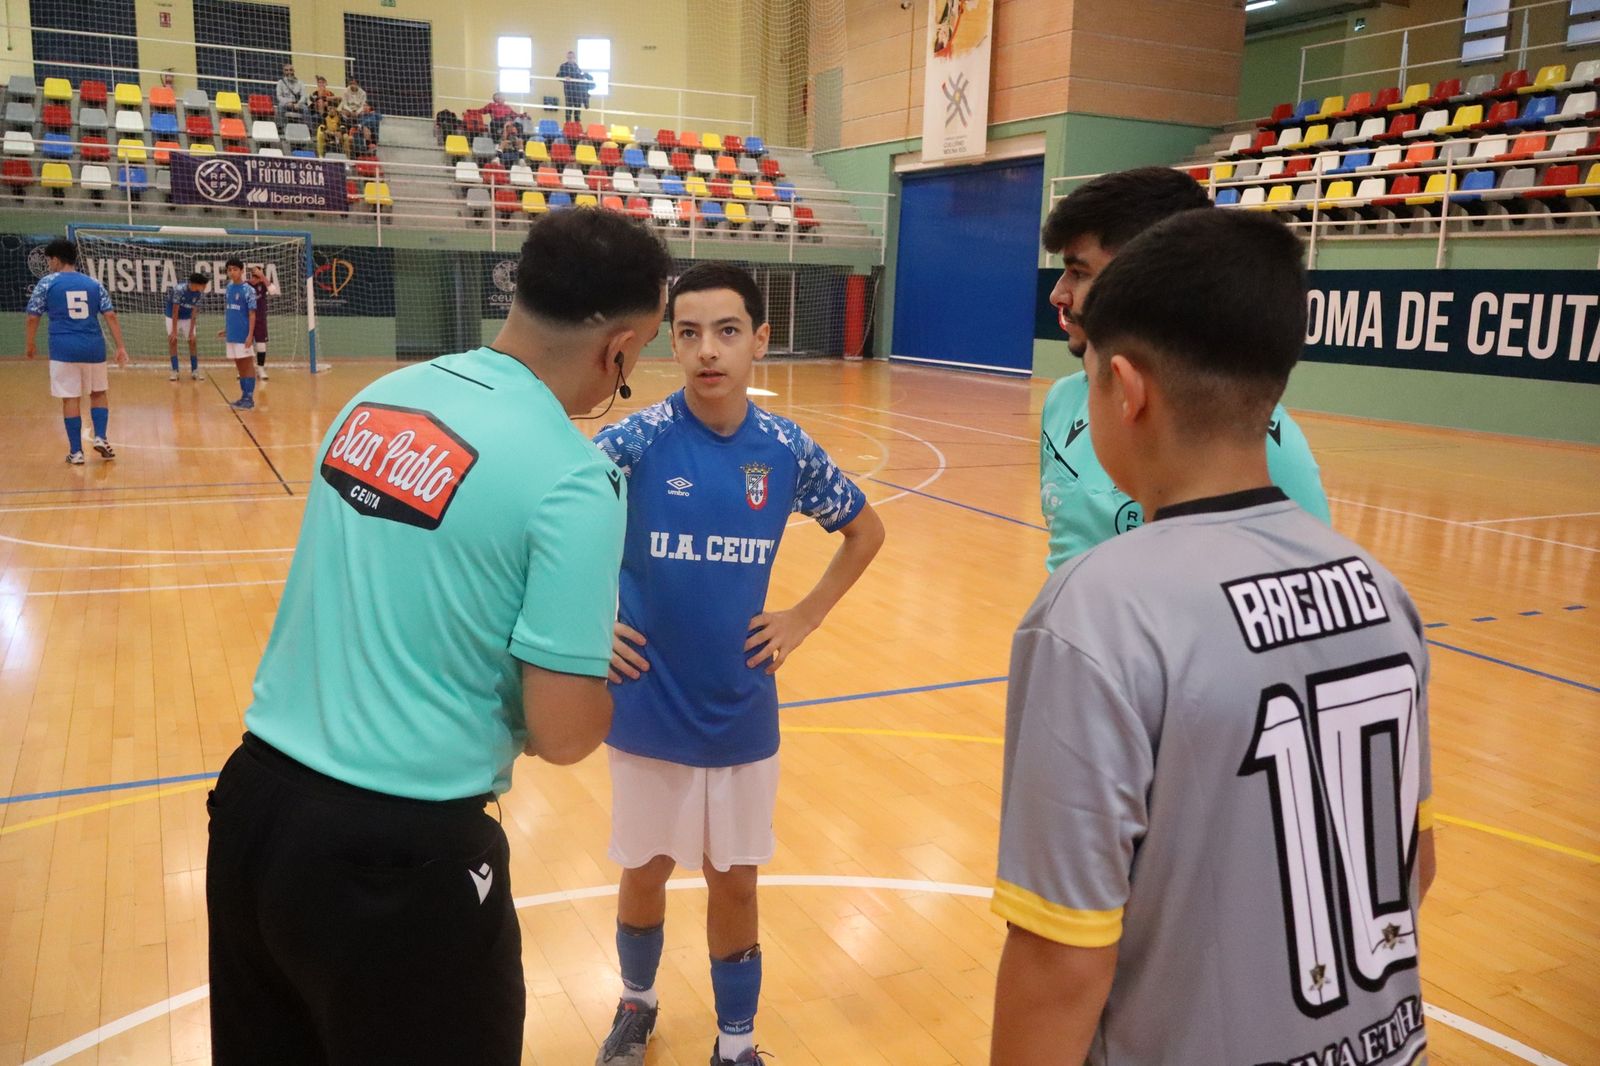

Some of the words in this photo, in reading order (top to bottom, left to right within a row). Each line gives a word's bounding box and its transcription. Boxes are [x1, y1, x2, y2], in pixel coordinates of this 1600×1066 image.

[258, 160, 323, 171] DIVISIÓN
[258, 166, 297, 185] FÚTBOL
[299, 170, 325, 187] SALA
[270, 191, 326, 206] Iberdrola
[86, 257, 178, 293] VISITA
[65, 290, 90, 320] 5
[1395, 290, 1455, 353] DE
[332, 411, 384, 472] San
[375, 429, 455, 503] Pablo
[350, 485, 381, 510] CEUTA
[667, 489, 690, 497] umbro
[650, 531, 702, 561] U.A.
[705, 535, 776, 565] CEUT
[1224, 558, 1388, 650] RACING
[1240, 655, 1418, 1016] 10
